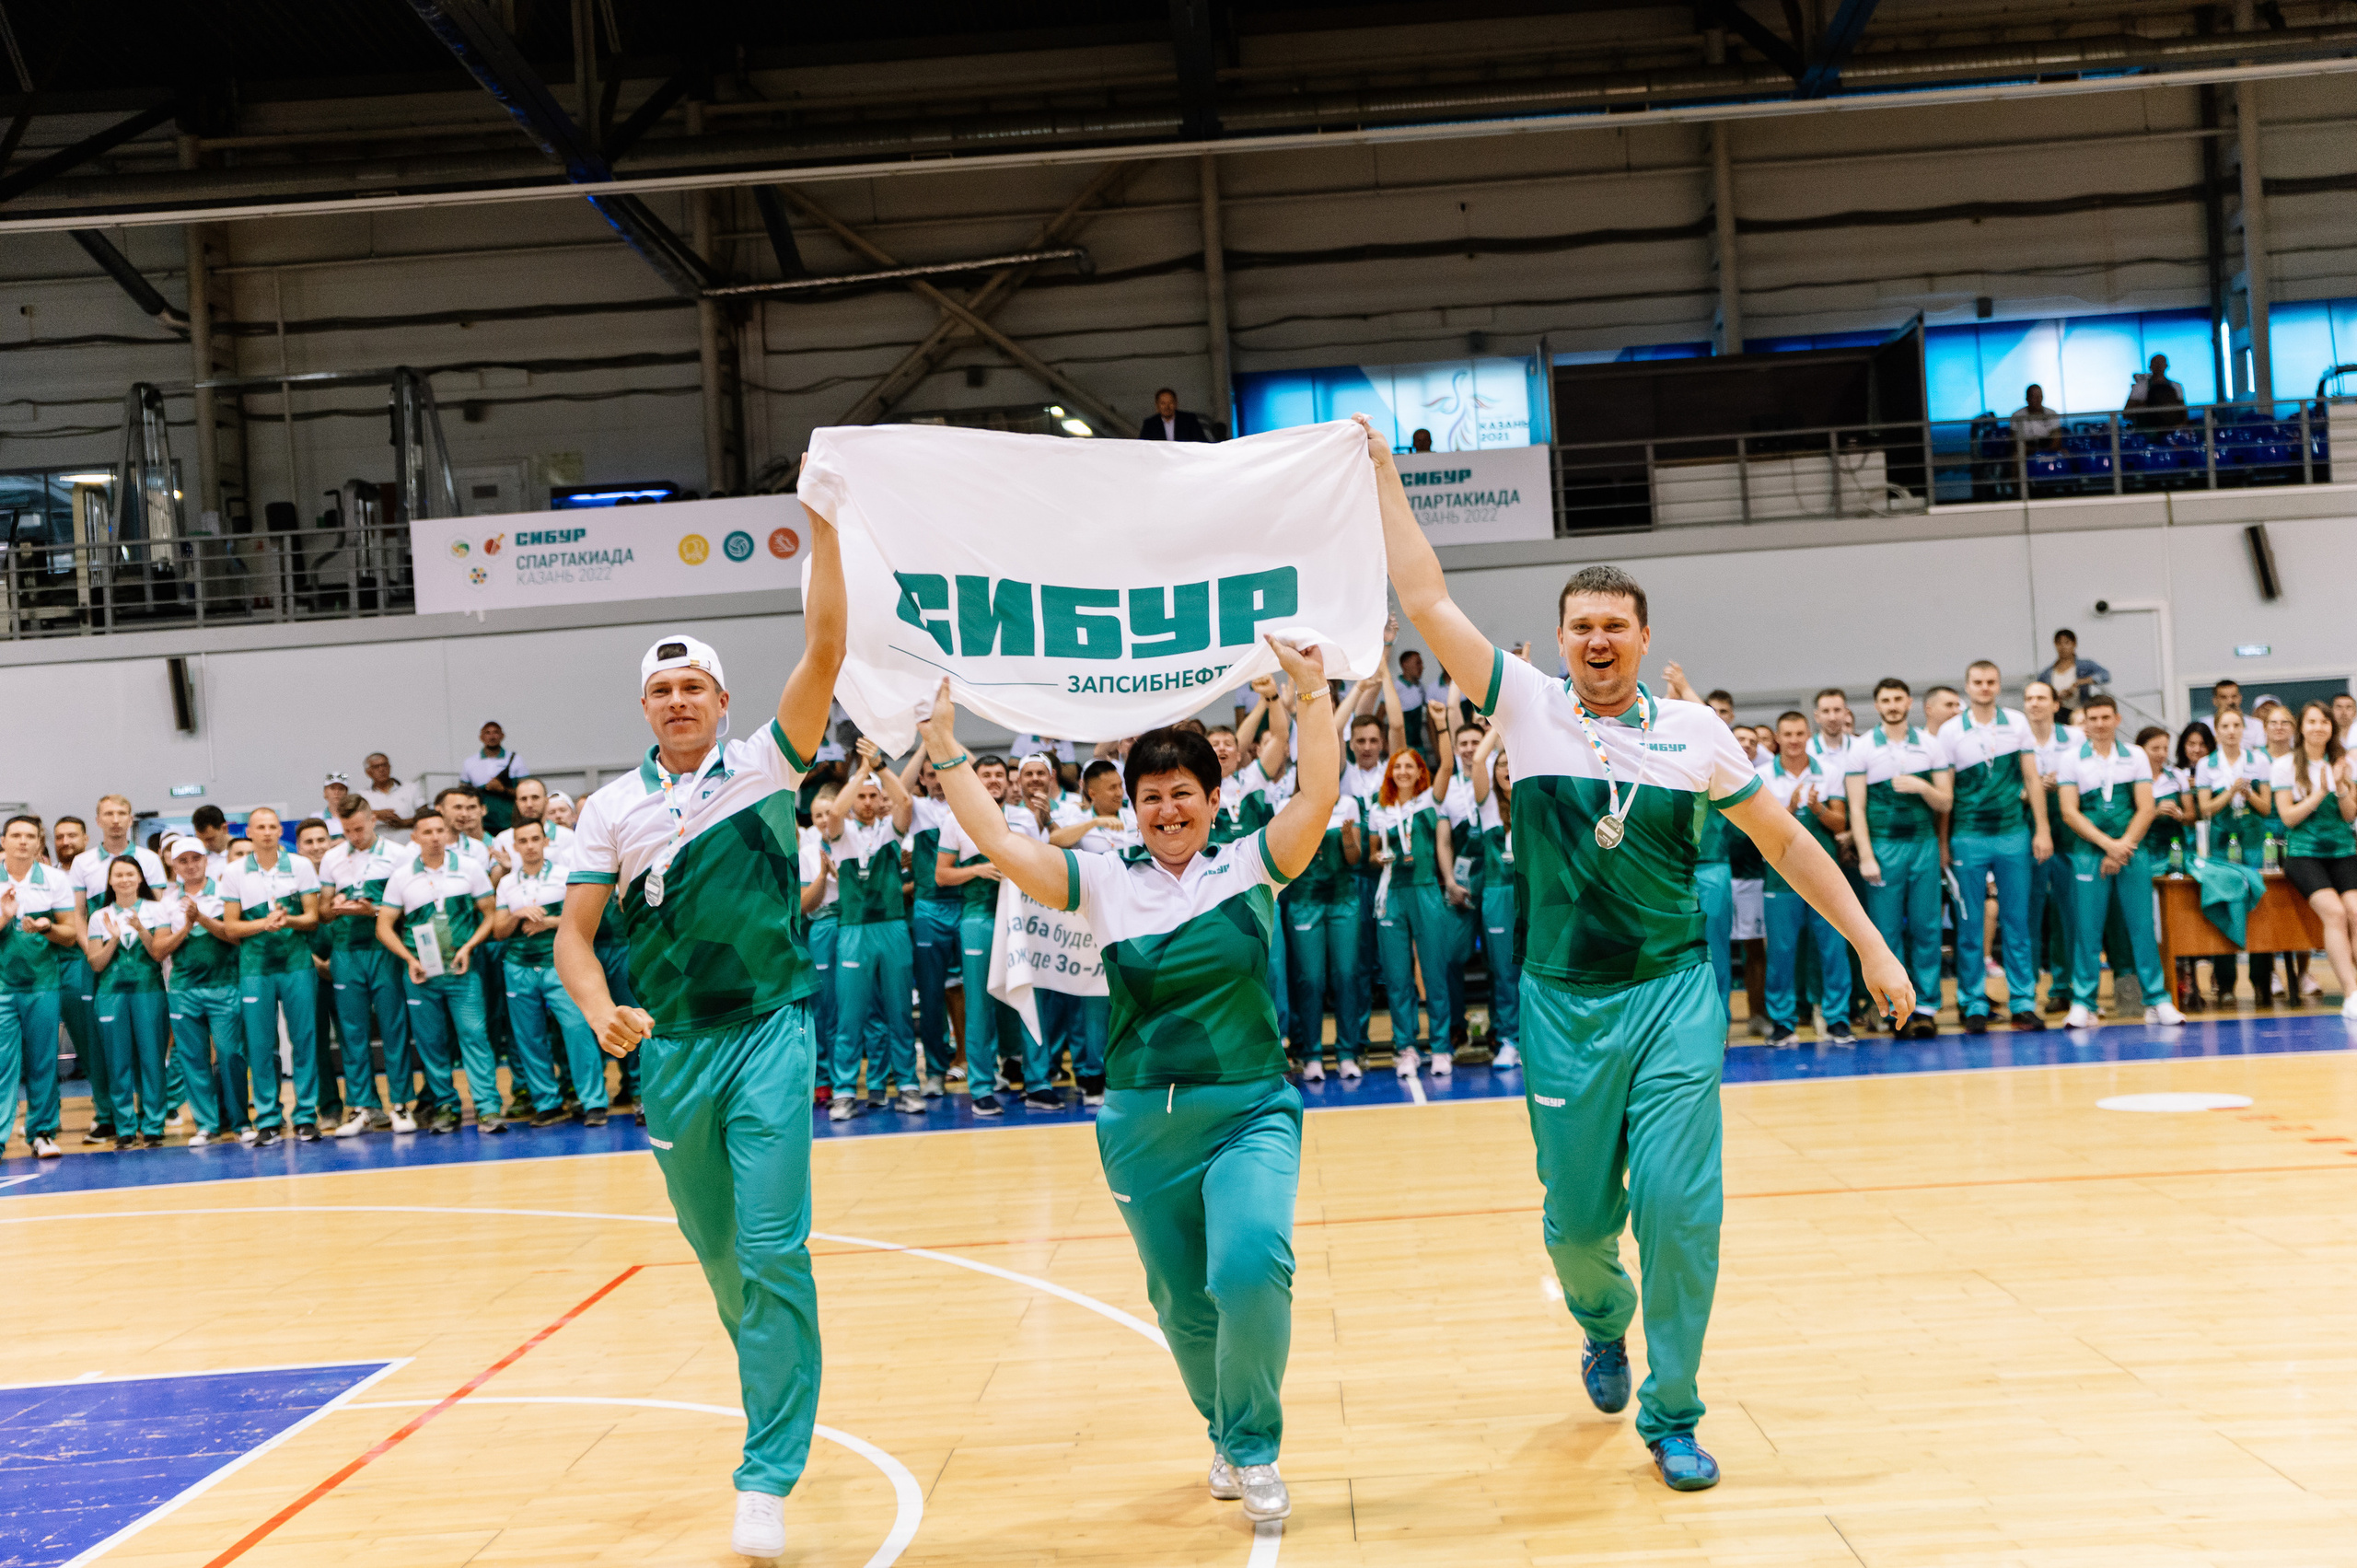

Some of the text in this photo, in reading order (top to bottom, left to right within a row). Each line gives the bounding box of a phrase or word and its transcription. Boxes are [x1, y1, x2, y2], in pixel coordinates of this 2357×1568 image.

[1400, 468, 1471, 487] СИБУР
[1408, 489, 1520, 511] ПАРТАКИАДА
[1464, 507, 1497, 523] 2022
[516, 528, 586, 546] СИБУР
[517, 548, 633, 570] СПАРТАКИАДА
[517, 566, 611, 586] КАЗАНЬ 2022
[1068, 664, 1235, 693] ЗАПСИБНЕФТ
[1053, 923, 1097, 951] буде
